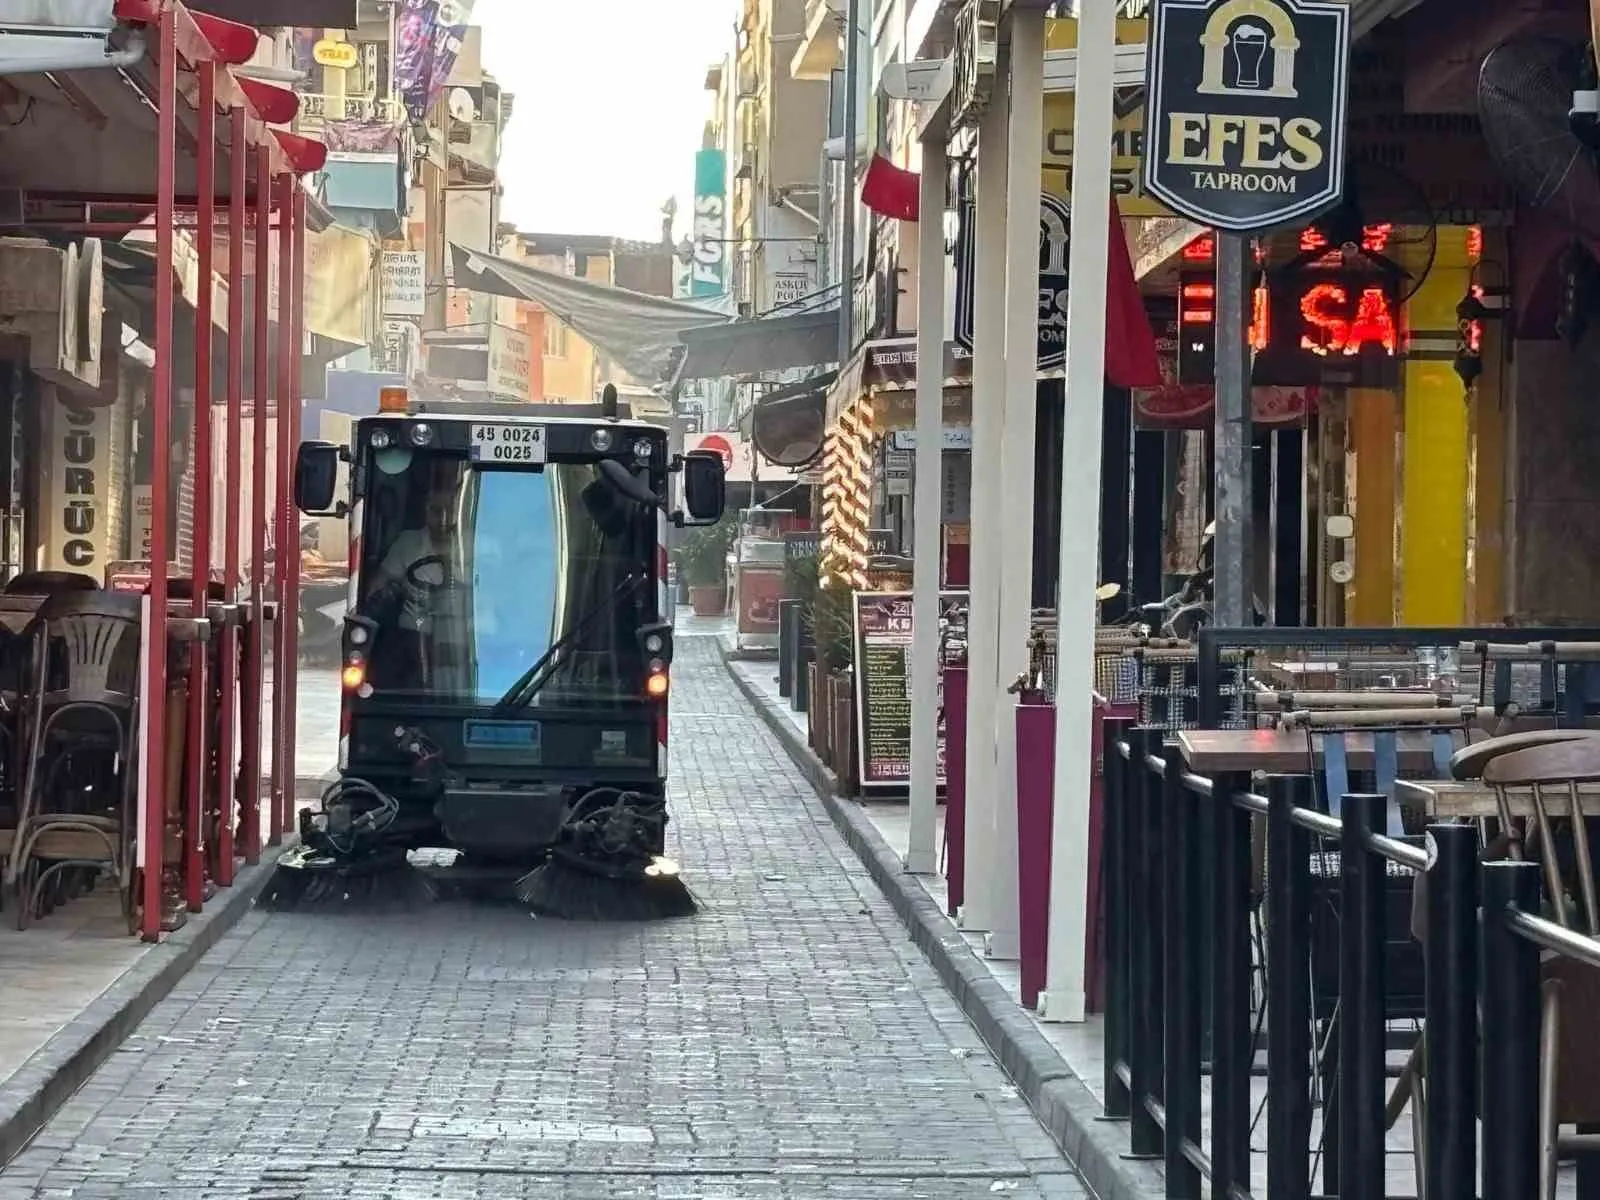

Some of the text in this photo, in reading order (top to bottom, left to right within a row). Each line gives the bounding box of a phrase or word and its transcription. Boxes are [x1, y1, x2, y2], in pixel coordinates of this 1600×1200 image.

[1166, 111, 1323, 171] EFES
[1191, 171, 1296, 193] TAPROOM
[503, 428, 540, 442] 0024
[494, 446, 532, 459] 0025
